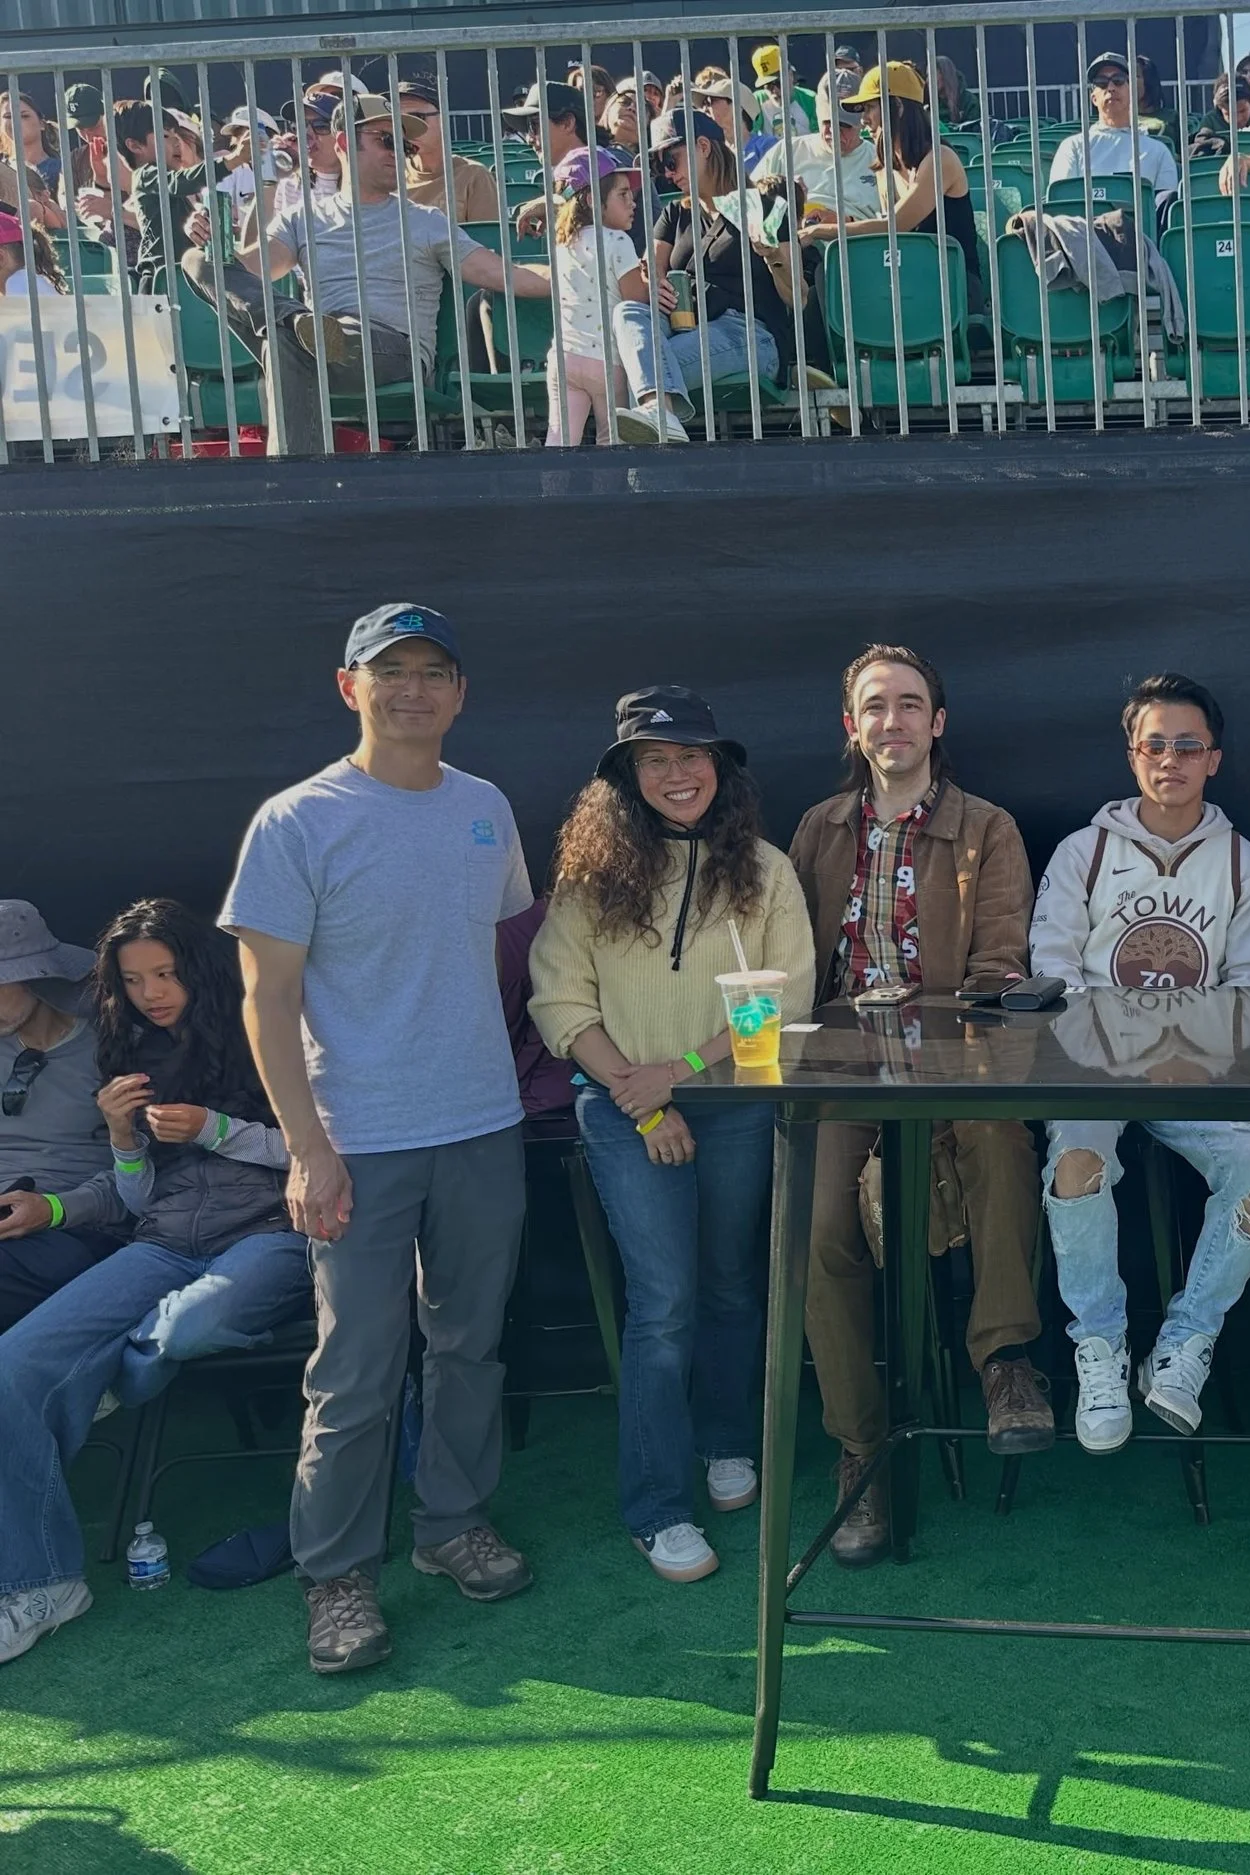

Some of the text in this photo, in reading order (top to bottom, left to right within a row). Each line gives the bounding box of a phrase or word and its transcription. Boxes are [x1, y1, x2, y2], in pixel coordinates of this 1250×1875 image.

[1094, 189, 1105, 199] 23
[1218, 241, 1232, 253] 24
[1117, 889, 1137, 906] The
[1110, 891, 1217, 933] TOWN
[902, 938, 918, 959] 5
